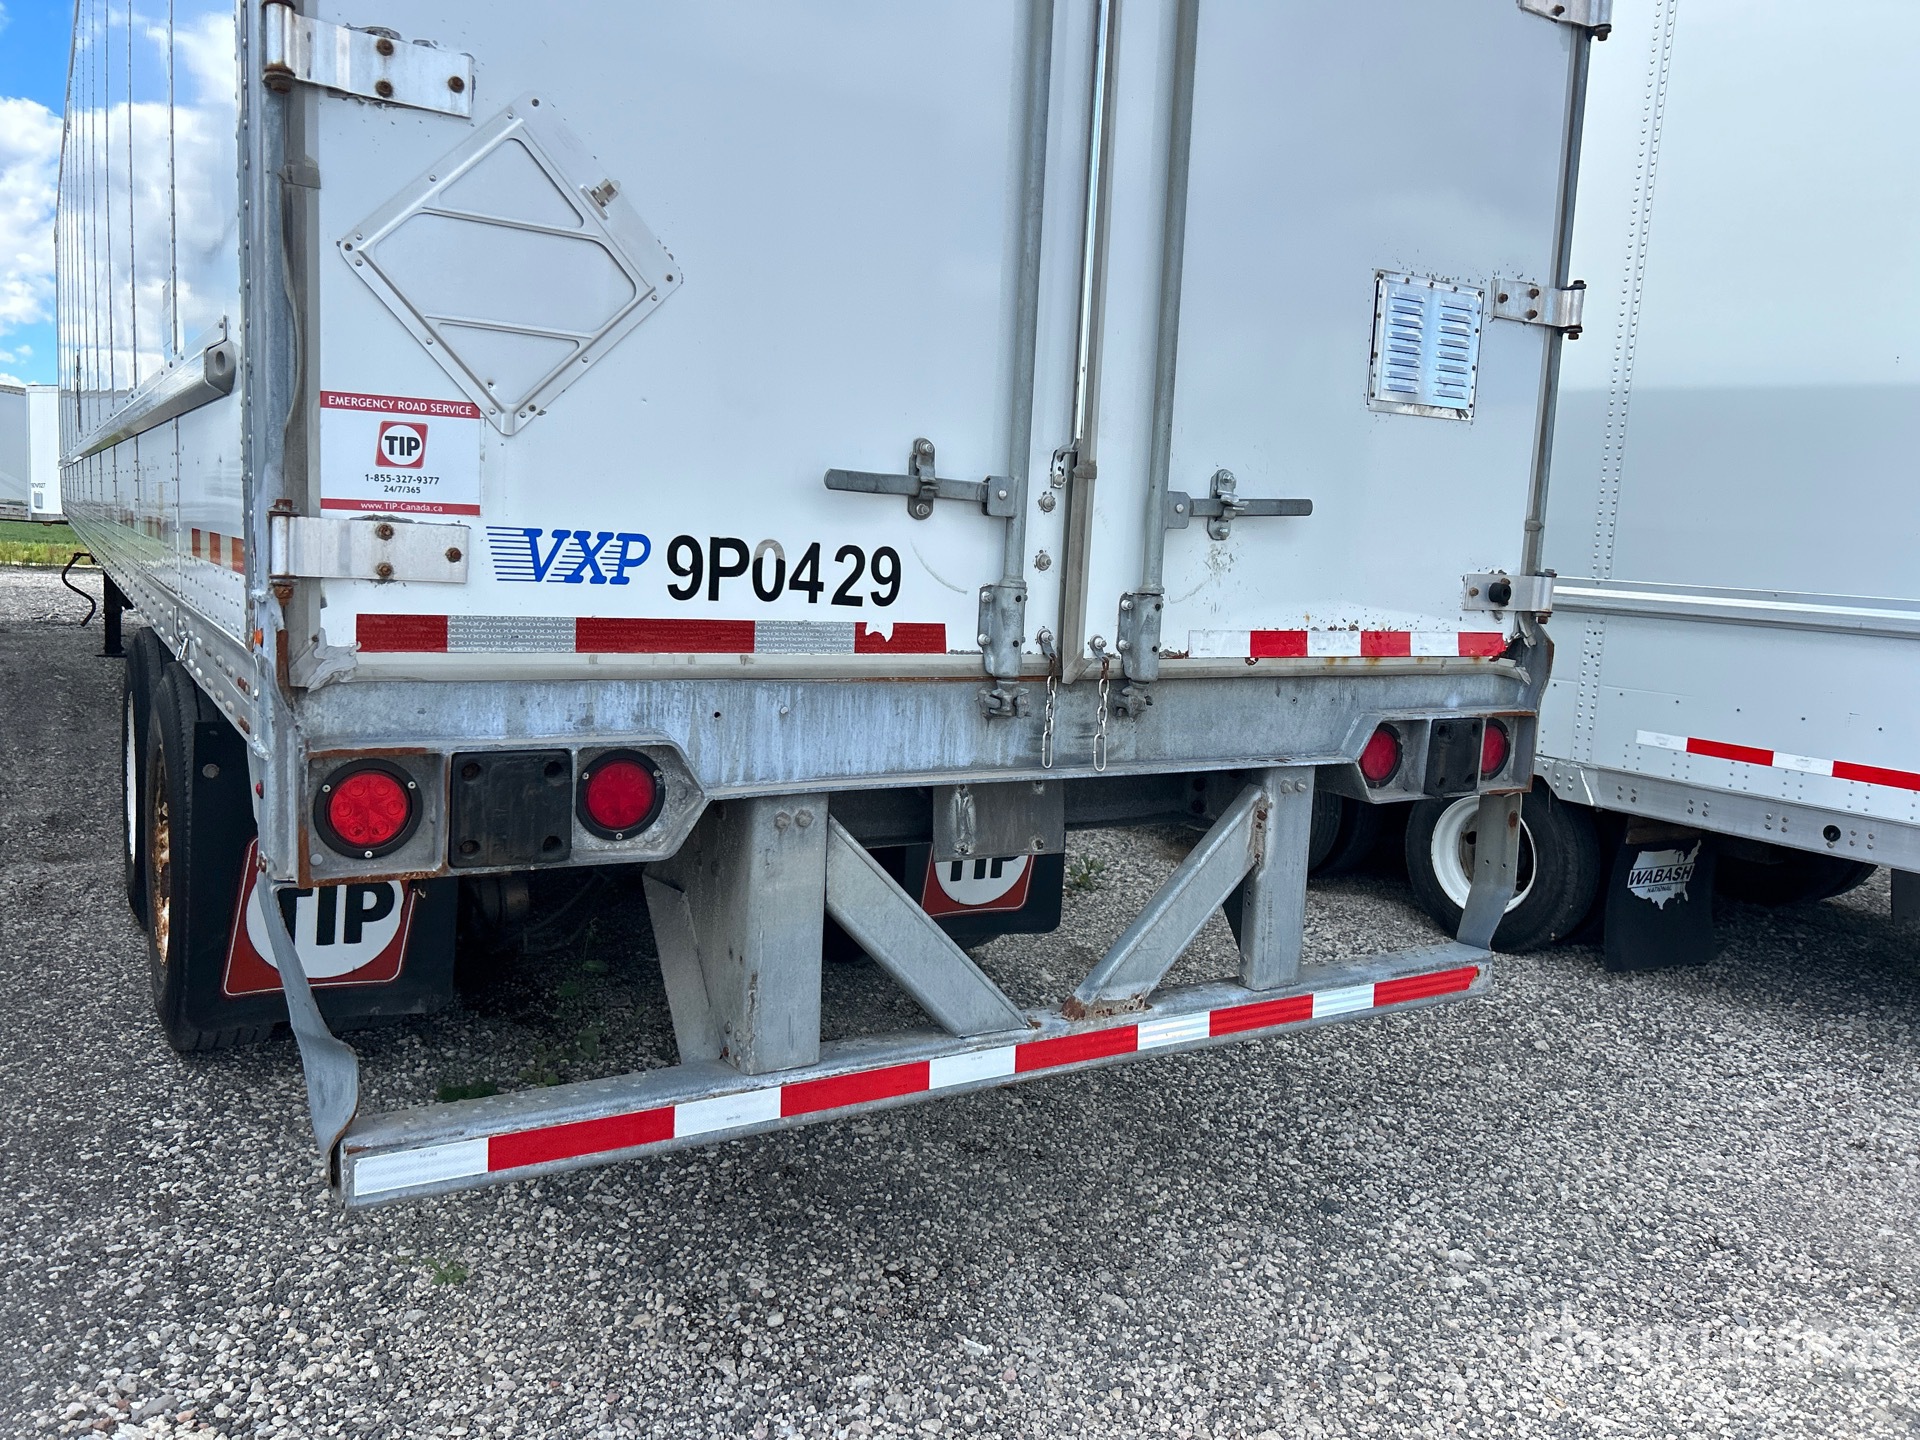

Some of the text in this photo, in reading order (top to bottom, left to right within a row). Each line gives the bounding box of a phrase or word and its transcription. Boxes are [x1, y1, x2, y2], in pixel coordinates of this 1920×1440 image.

[328, 395, 472, 415] EMERGENCY ROAD SERVICE
[384, 435, 421, 456] TIP
[364, 473, 440, 485] 1-855-327-9377
[383, 484, 421, 494] 24/7/365
[360, 502, 443, 513] www.TIP-Canada.ca
[523, 528, 901, 608] VXP 9P0429
[1628, 865, 1694, 886] WABASH
[1646, 885, 1672, 893] NATIONAL
